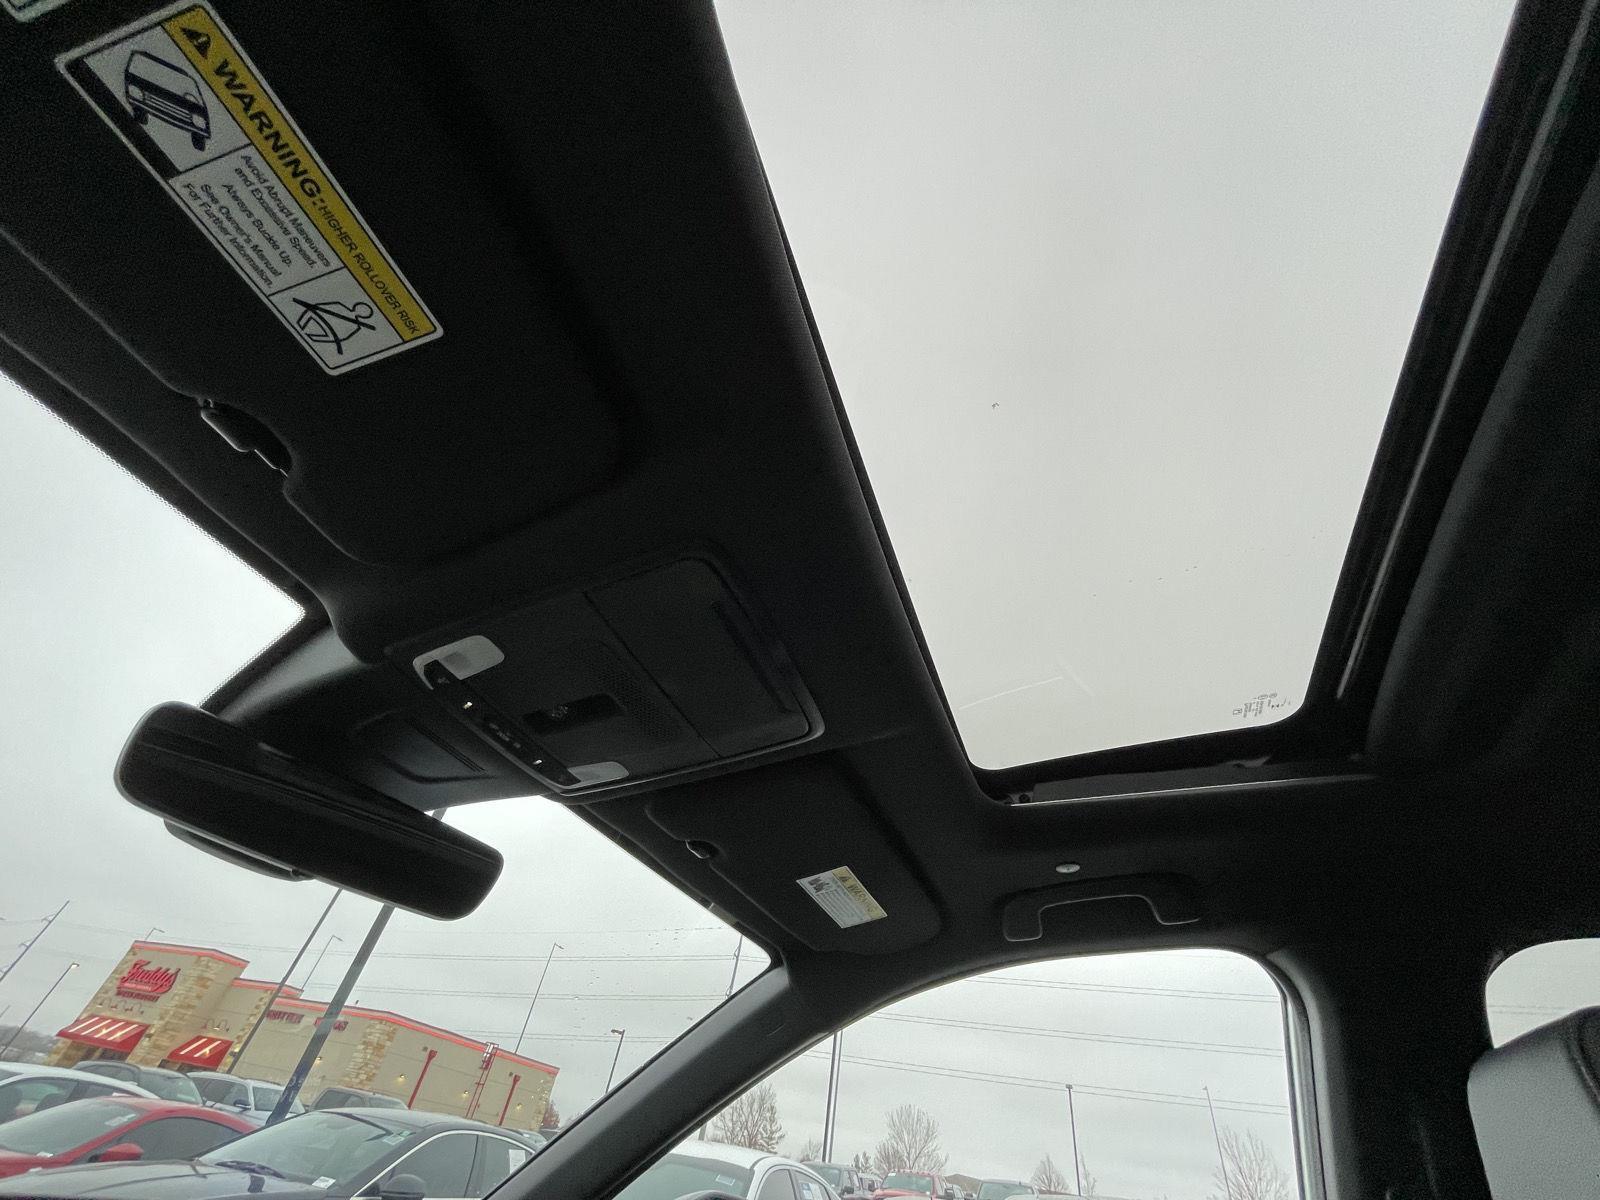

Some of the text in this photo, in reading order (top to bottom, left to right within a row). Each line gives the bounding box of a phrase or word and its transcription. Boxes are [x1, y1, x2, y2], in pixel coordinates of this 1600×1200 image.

[183, 182, 273, 288] For Further Information.
[201, 183, 282, 277] See Owner's Manual
[213, 59, 420, 335] WARNING: HIGHER ROLLOVER RISK
[221, 184, 292, 267] Always Buckle Up.
[234, 168, 318, 268] and Excessive Speed.
[241, 155, 331, 267] Avoid Abrupt Maneuvers
